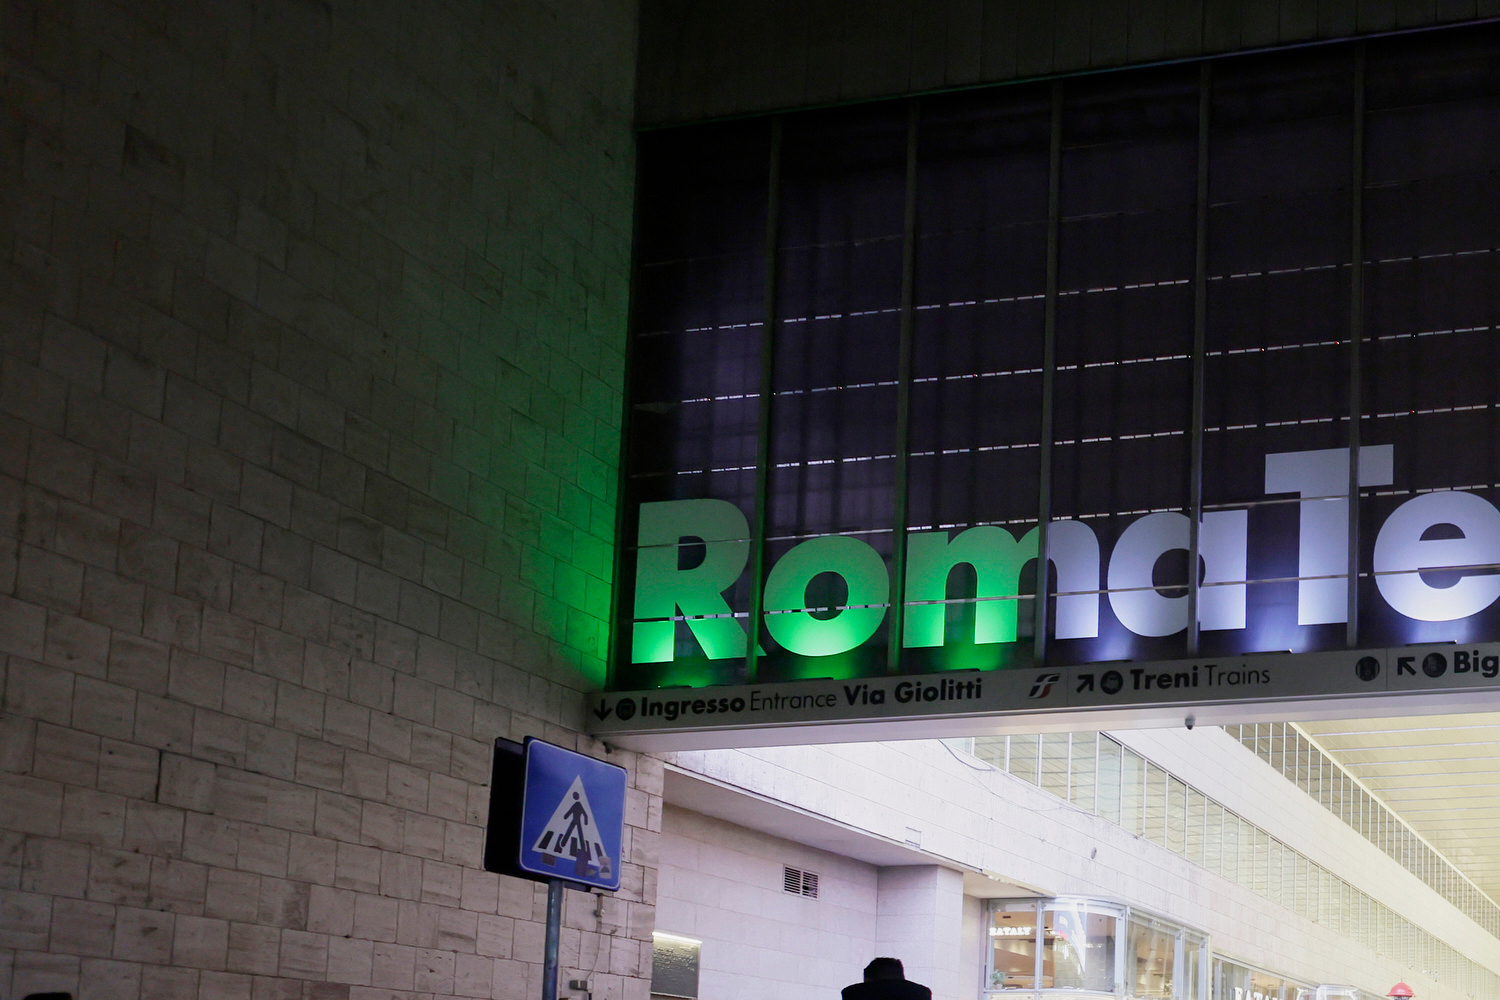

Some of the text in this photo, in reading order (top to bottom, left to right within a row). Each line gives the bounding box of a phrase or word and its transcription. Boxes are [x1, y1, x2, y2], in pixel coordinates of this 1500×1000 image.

[1130, 664, 1270, 691] Treni Trains
[641, 677, 982, 721] Ingresso Entrance Via Giolitti
[989, 926, 1032, 936] EATALY
